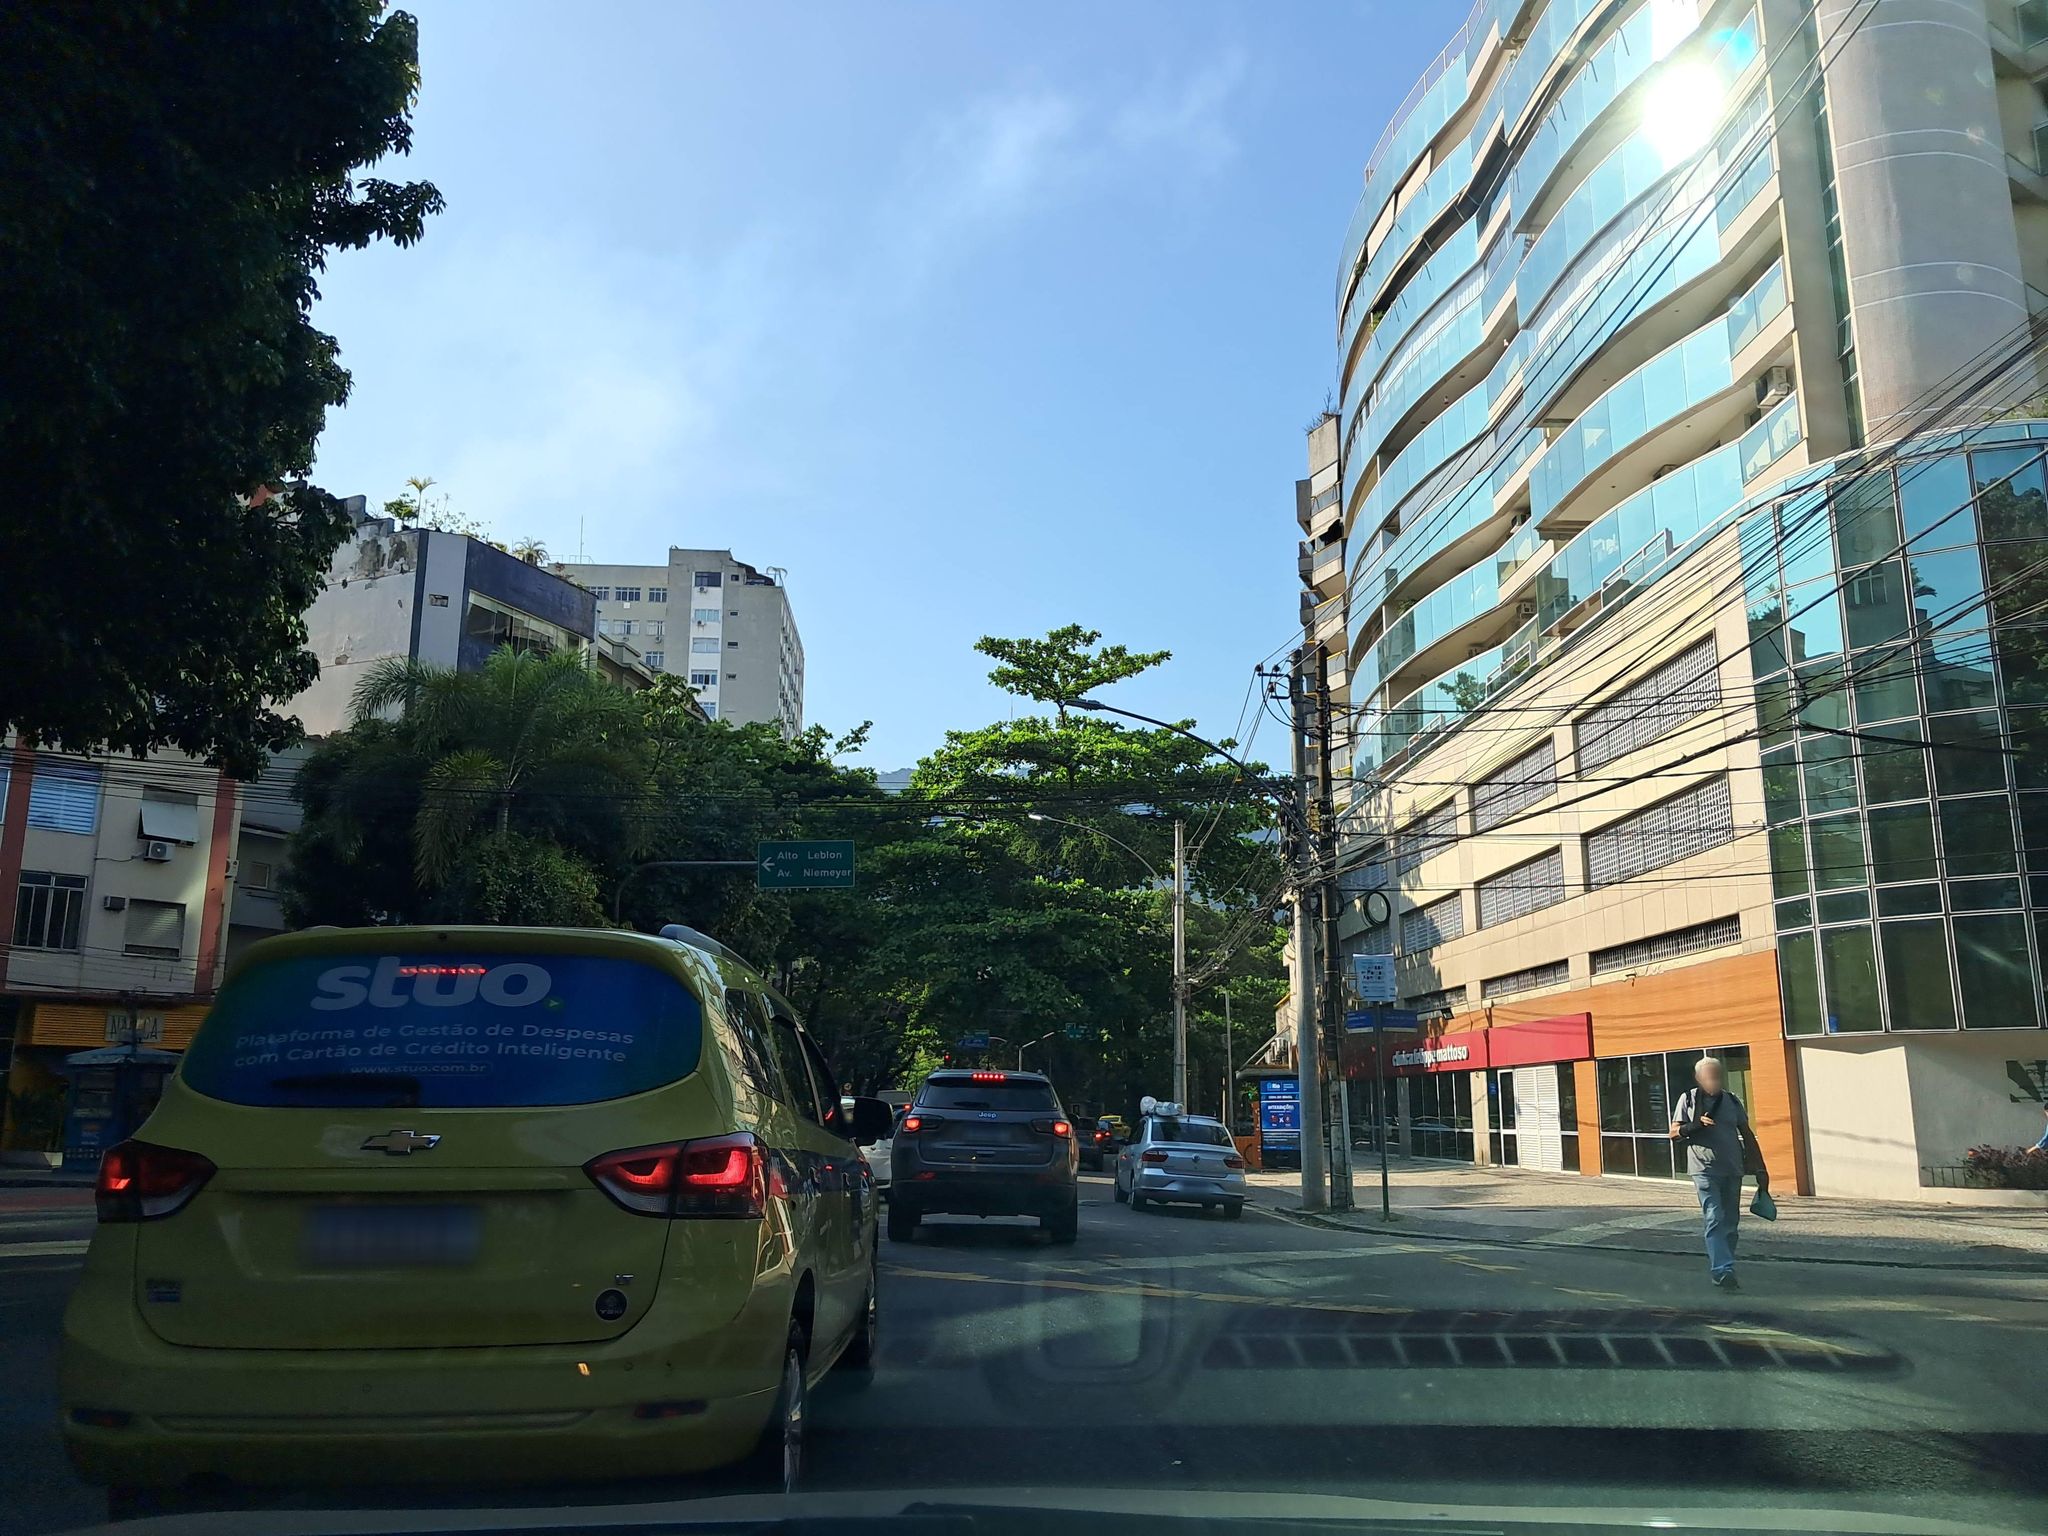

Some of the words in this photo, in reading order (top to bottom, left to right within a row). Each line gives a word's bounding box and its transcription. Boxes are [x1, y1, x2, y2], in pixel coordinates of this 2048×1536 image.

[777, 850, 799, 860] Alto
[807, 850, 842, 860] Leblon
[777, 869, 792, 878] Av.
[803, 868, 852, 879] Niemeyer
[310, 956, 552, 1011] stuo
[235, 1028, 354, 1048] Plataforma
[363, 1025, 392, 1038] de
[398, 1022, 478, 1037] Gestão
[485, 1023, 515, 1037] de
[521, 1023, 635, 1044] Despesas
[233, 1052, 280, 1067] com
[287, 1044, 361, 1061] Cartão
[369, 1043, 398, 1056] de
[404, 1040, 490, 1056] Crédito
[497, 1041, 627, 1063] Inteligente
[350, 1063, 487, 1073] www.stuo.com.br
[978, 1111, 997, 1119] Jeep
